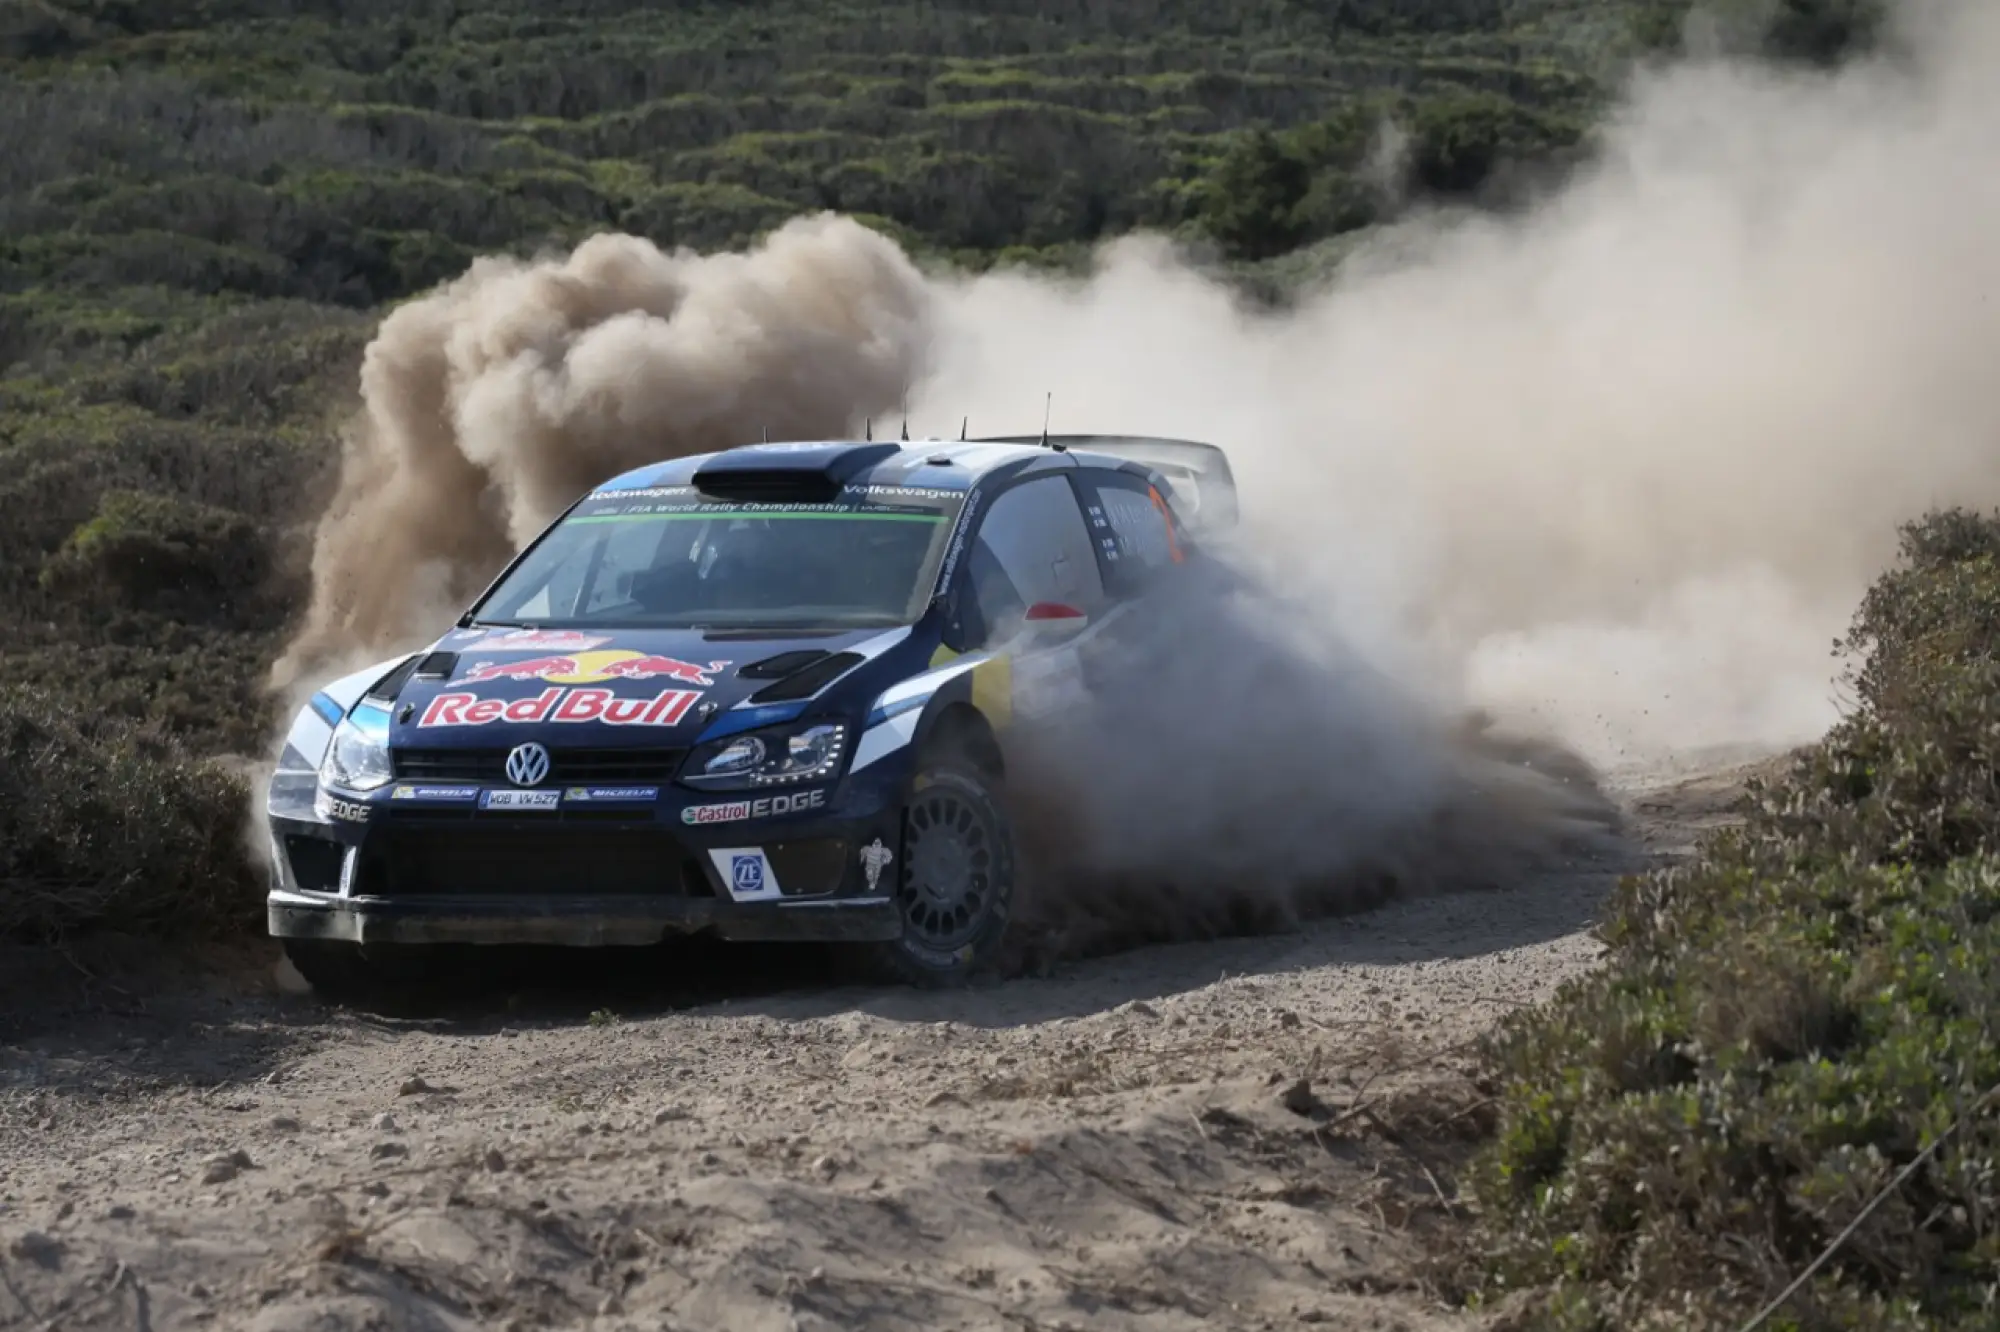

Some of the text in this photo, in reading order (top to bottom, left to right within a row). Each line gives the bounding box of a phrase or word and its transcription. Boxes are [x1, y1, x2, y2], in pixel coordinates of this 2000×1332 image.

[843, 484, 965, 500] Volkswagen
[656, 503, 698, 512] World
[700, 503, 737, 511] Rally
[741, 502, 849, 513] Championship
[417, 687, 703, 728] Red Bull
[490, 794, 512, 806] WOB
[592, 789, 656, 798] MICHELIN
[331, 799, 373, 823] EDGE
[697, 789, 825, 822] Castrol EDGE
